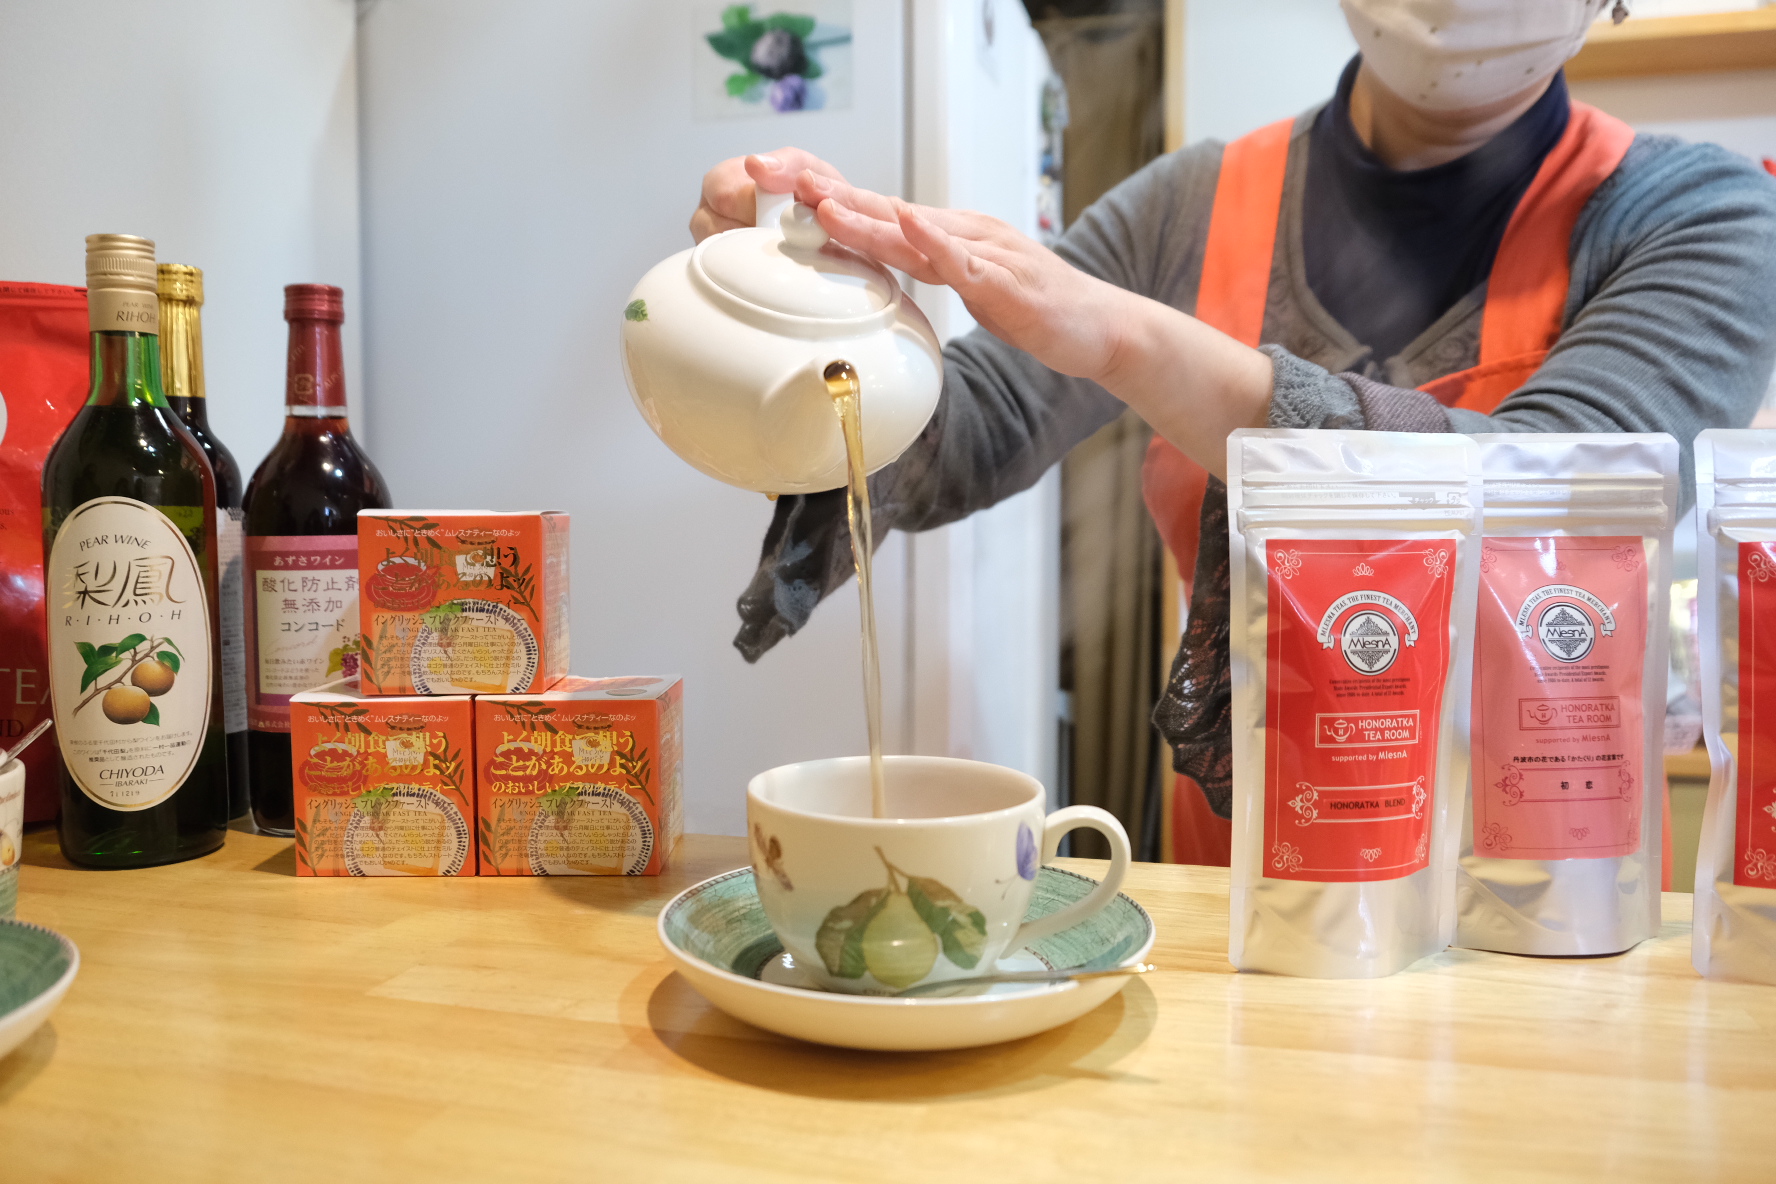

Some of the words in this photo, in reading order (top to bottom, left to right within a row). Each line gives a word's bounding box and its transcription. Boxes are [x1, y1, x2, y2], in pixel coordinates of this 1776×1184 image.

[79, 534, 109, 551] PEAR
[114, 533, 151, 549] WINE
[273, 555, 345, 567] あずさワイン
[261, 576, 360, 594] 酸化防止剤
[281, 597, 344, 614] 無添加
[1541, 588, 1554, 597] THE
[1574, 591, 1586, 600] TEA
[1586, 596, 1612, 625] MERCHANT
[373, 614, 427, 626] イングリッシュ
[1320, 611, 1336, 637] MLESNA
[1347, 594, 1360, 604] THE
[1360, 593, 1381, 602] FINEST
[1382, 597, 1394, 607] TEA
[1393, 603, 1417, 635] MERCHANT
[280, 618, 346, 633] コンコード
[1560, 703, 1616, 714] HONORATKA
[1358, 717, 1414, 729] HONORATKA
[1566, 714, 1584, 724] TEA
[1586, 714, 1612, 723] ROOM
[497, 729, 634, 753] よく朝食で想う
[1364, 731, 1382, 741] TEA
[1384, 729, 1410, 740] ROOM
[1535, 736, 1571, 745] supported
[1581, 734, 1611, 743] MlesnA
[1331, 753, 1367, 762] supported
[1368, 753, 1377, 761] by
[1378, 749, 1408, 760] MlesnA
[99, 764, 165, 780] CHIYODA
[305, 755, 457, 778] ことがあるのよッ
[490, 754, 643, 777] ことがあるのよッ
[114, 778, 148, 788] IBARAKI
[307, 798, 358, 810] イングリッシュ
[491, 797, 543, 809] イングリッシュ
[1330, 801, 1380, 811] HONORATKA
[1384, 798, 1406, 808] BLEND
